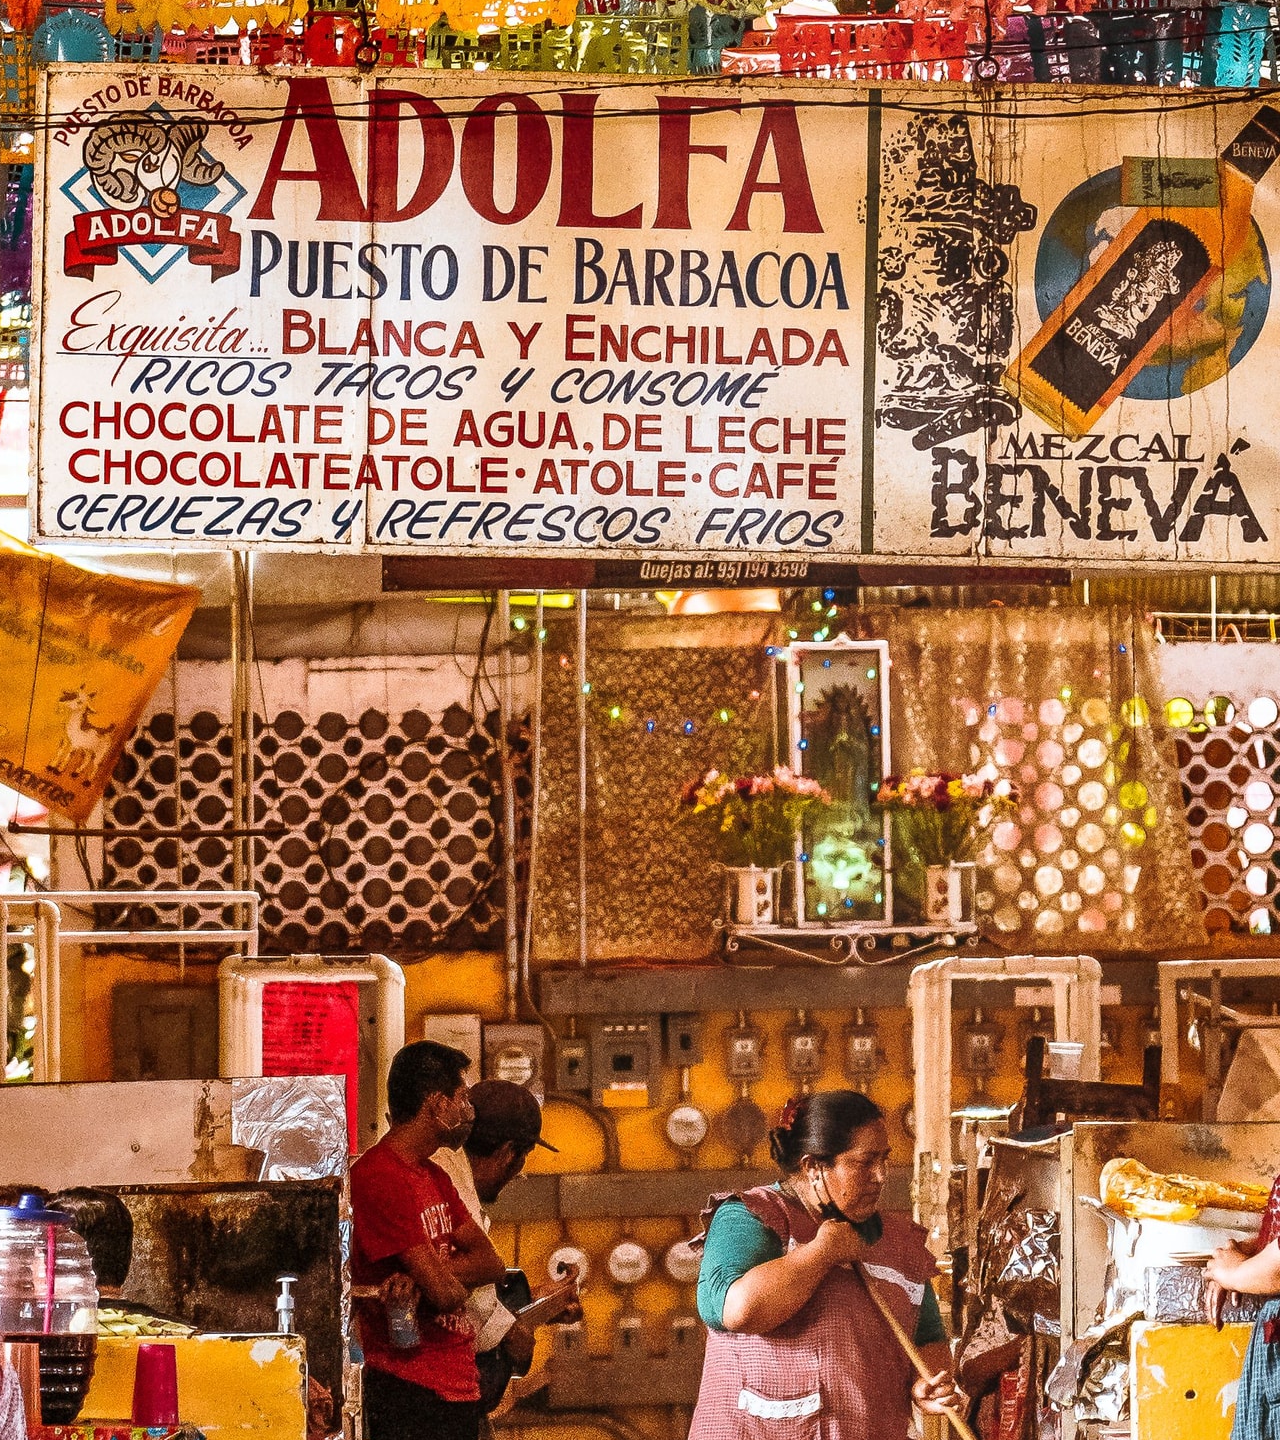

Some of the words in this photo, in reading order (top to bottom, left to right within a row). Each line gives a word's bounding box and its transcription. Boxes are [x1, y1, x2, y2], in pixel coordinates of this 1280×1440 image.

[54, 88, 123, 147] PUESTO
[125, 77, 151, 98] DE
[157, 76, 252, 153] BARBACOA
[247, 77, 824, 233] ADOLFA
[87, 211, 222, 246] ADOLFA
[249, 229, 459, 301] PUESTO
[482, 244, 549, 304] DE
[573, 237, 849, 311] BARBACOA
[282, 309, 484, 360] BLANCA
[516, 322, 542, 362] Y
[565, 315, 848, 367] ENCHILADA
[130, 360, 293, 397] RICOS
[314, 362, 472, 401] TACOS
[550, 364, 786, 409] CONSOMÉ
[59, 402, 350, 446] CHOCOLATE
[369, 409, 426, 446] DE
[684, 415, 847, 455] LECHE
[1001, 432, 1206, 463] MEZCAL
[57, 496, 312, 540] CERVEZAS
[377, 499, 668, 544] REFRESCOS
[699, 506, 844, 548] FRIOS
[640, 562, 691, 582] Quejas
[695, 562, 714, 578] al:
[717, 562, 742, 578] 951
[745, 563, 767, 578] 194
[772, 564, 808, 578] 3598
